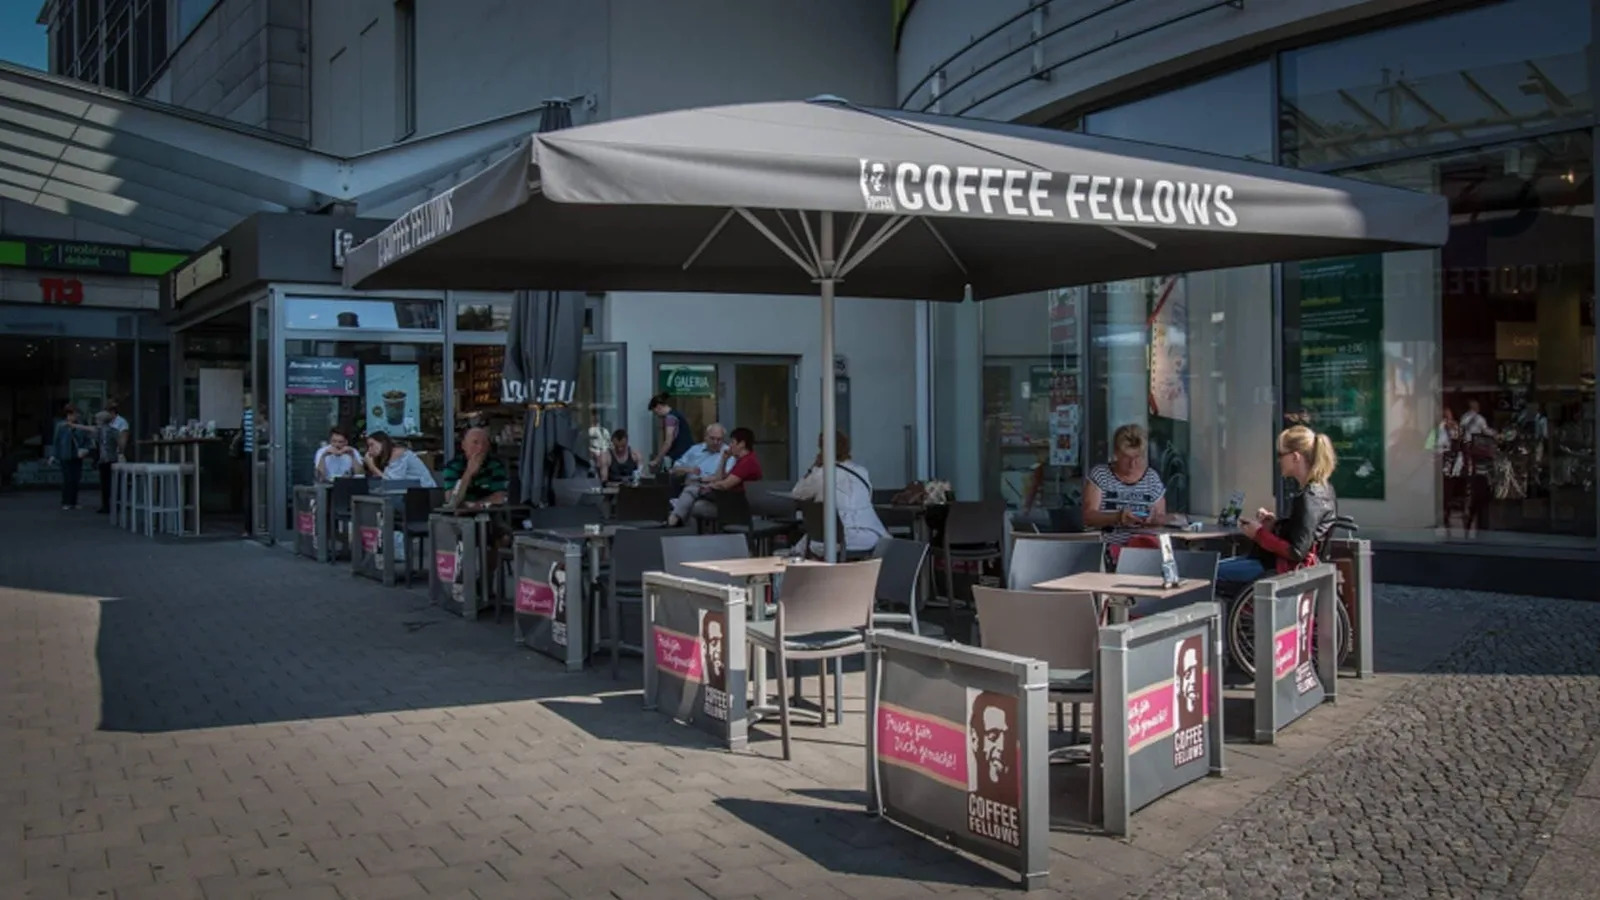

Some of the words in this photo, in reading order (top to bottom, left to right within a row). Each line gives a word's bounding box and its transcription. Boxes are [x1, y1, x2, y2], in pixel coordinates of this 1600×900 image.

[896, 161, 1054, 217] COFFEE
[1066, 174, 1238, 227] FELLOWS
[674, 375, 709, 388] GALERIA
[1174, 723, 1203, 751] COFFEE
[1174, 743, 1204, 768] FELLOWS
[969, 793, 1019, 829] COFFEE
[969, 815, 1020, 848] FELLOWS
